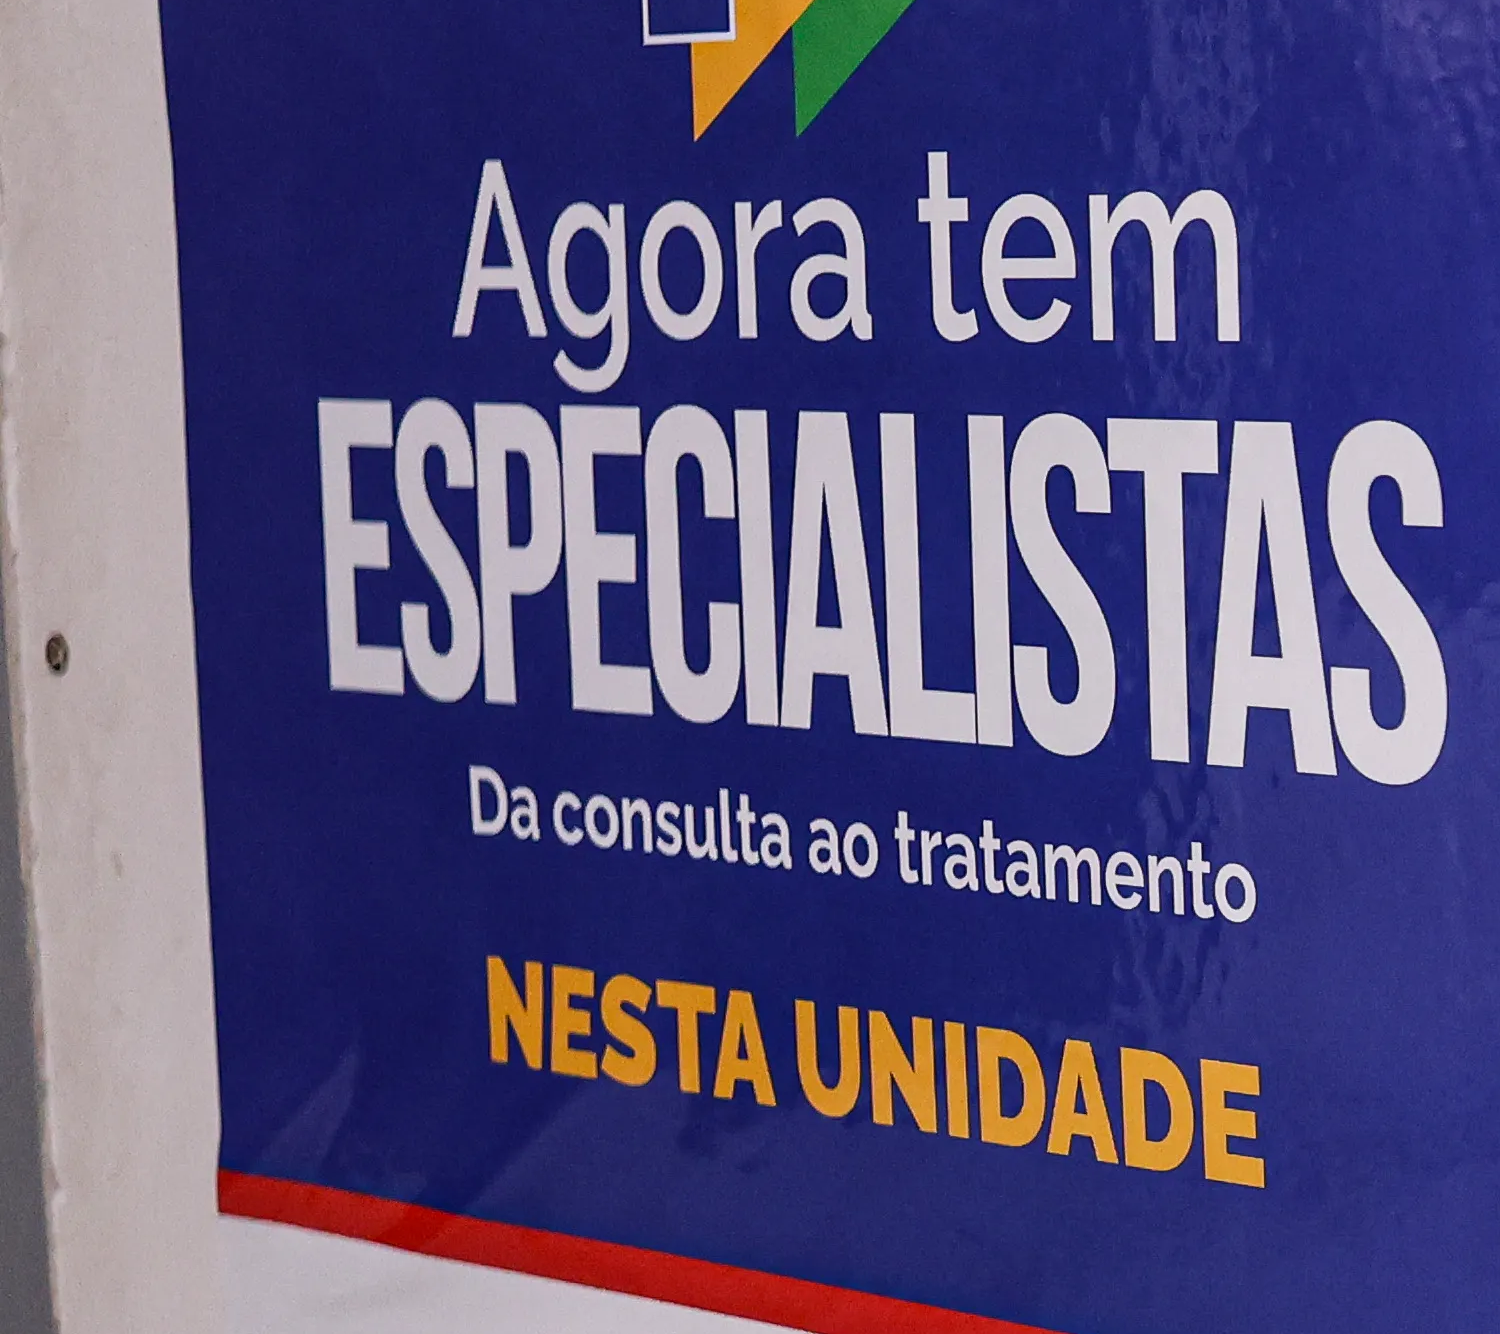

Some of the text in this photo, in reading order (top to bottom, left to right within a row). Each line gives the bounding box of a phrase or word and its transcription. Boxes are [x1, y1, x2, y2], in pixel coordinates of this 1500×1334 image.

[452, 152, 1240, 393] Agora tem
[317, 396, 1449, 787] ESPECIALISTAS
[468, 765, 1257, 924] Da consulta ao tratamento
[486, 955, 1265, 1189] NESTA UNIDADE
